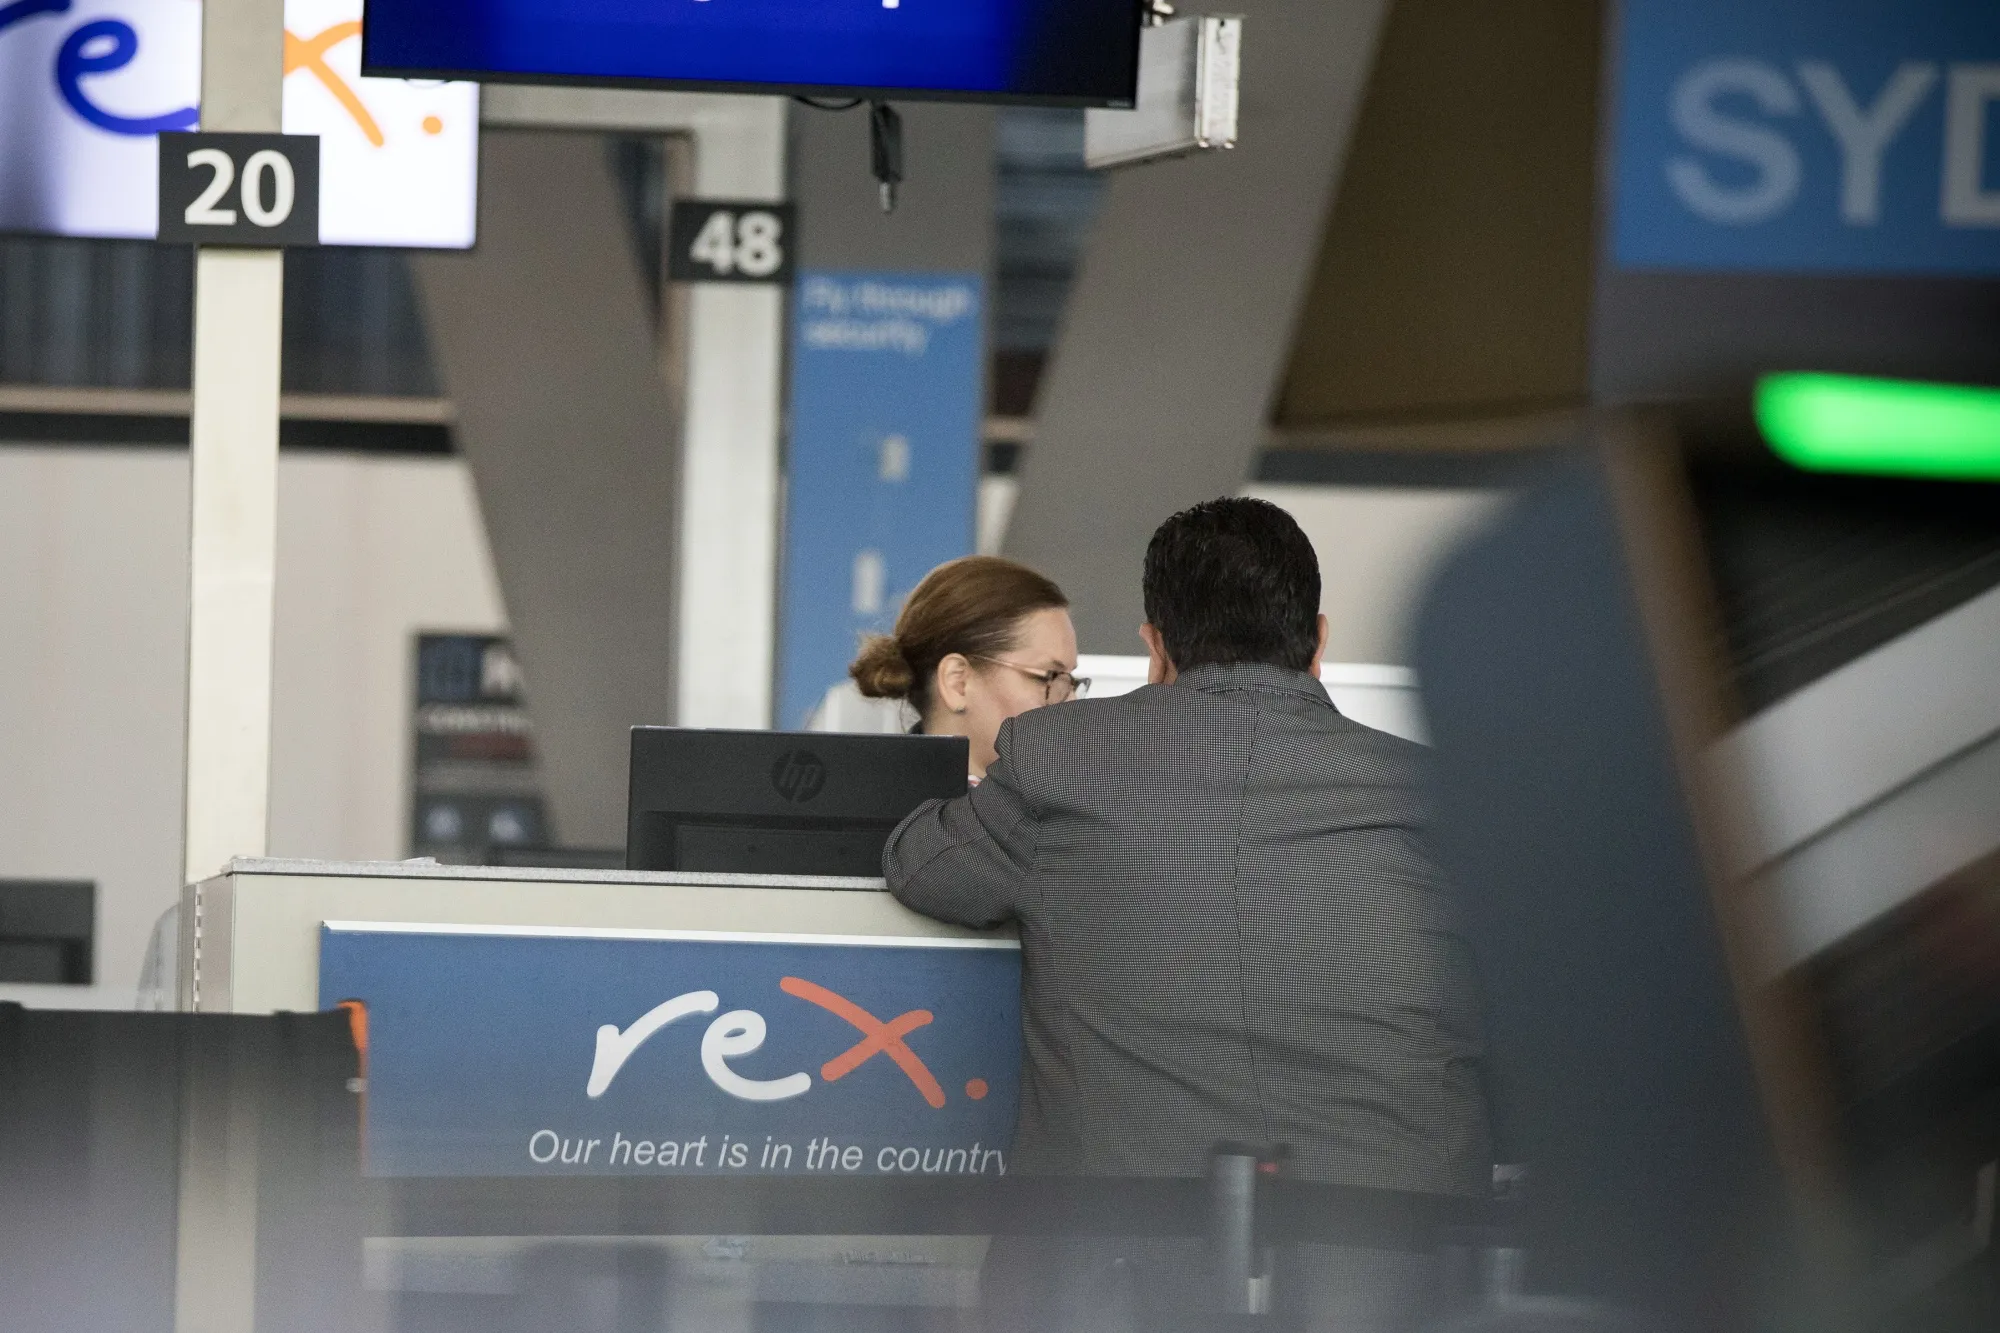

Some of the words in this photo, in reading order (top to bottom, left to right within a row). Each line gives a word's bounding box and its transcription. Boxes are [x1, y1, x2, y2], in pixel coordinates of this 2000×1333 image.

[184, 148, 296, 227] 20
[689, 210, 784, 277] 48
[777, 752, 823, 801] hp
[529, 1129, 600, 1163] Our
[609, 1132, 707, 1166] heart
[718, 1134, 748, 1168] is
[760, 1136, 792, 1169] in
[806, 1137, 863, 1170] the
